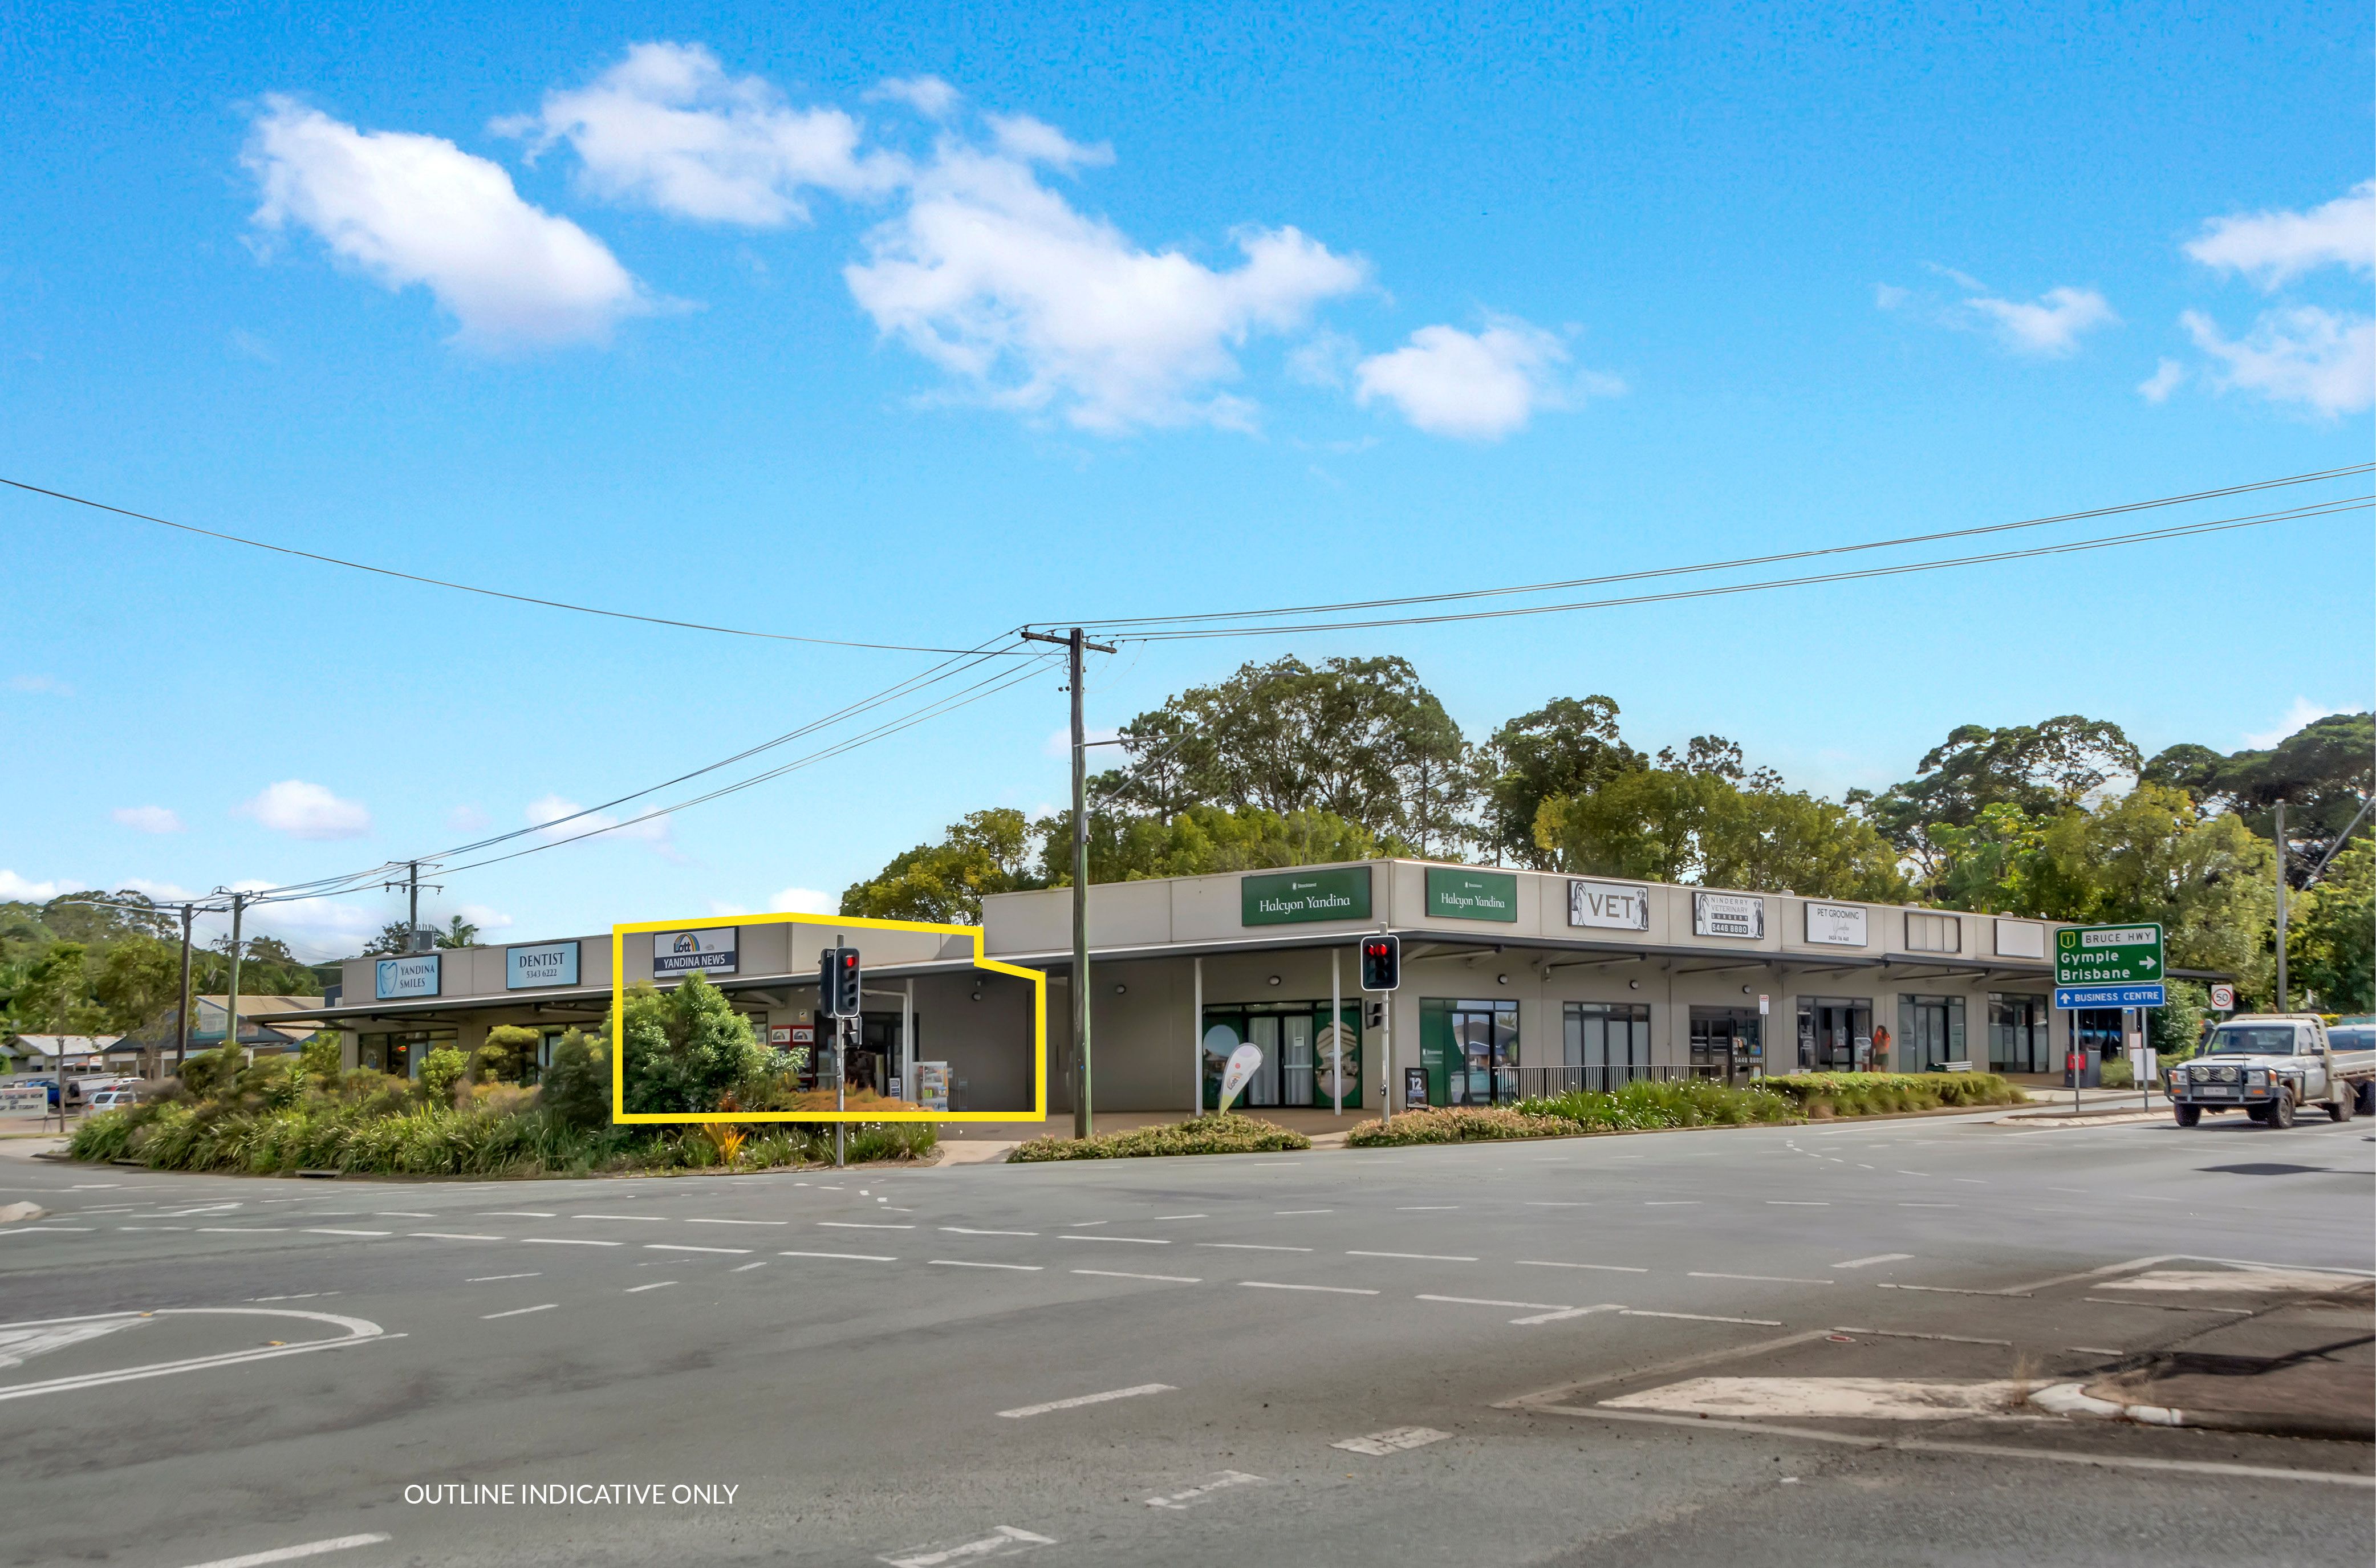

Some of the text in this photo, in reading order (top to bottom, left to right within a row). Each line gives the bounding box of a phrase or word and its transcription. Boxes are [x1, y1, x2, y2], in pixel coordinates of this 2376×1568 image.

[1260, 893, 1351, 915] Halcyon Yandina
[1441, 892, 1505, 909] Halcyon Yandina
[1587, 893, 1635, 919] VET
[1711, 897, 1748, 905] NINDERRY
[1711, 904, 1748, 913] VETERINARY
[1817, 908, 1859, 920] PET GROOMING
[1712, 924, 1747, 933] 5446 8880
[2085, 932, 2151, 944] BRUCE HWY
[519, 952, 565, 968] DENTIST
[664, 954, 725, 969] YANDINA NEWS
[2061, 950, 2119, 966] Gympie
[400, 964, 435, 976] YANDINA
[526, 968, 557, 978] 5343 6222
[2061, 968, 2131, 981] Brisbane
[400, 978, 425, 989] SMILES
[2074, 991, 2159, 1002] BUSINESS CENTRE
[2216, 993, 2228, 1002] 50
